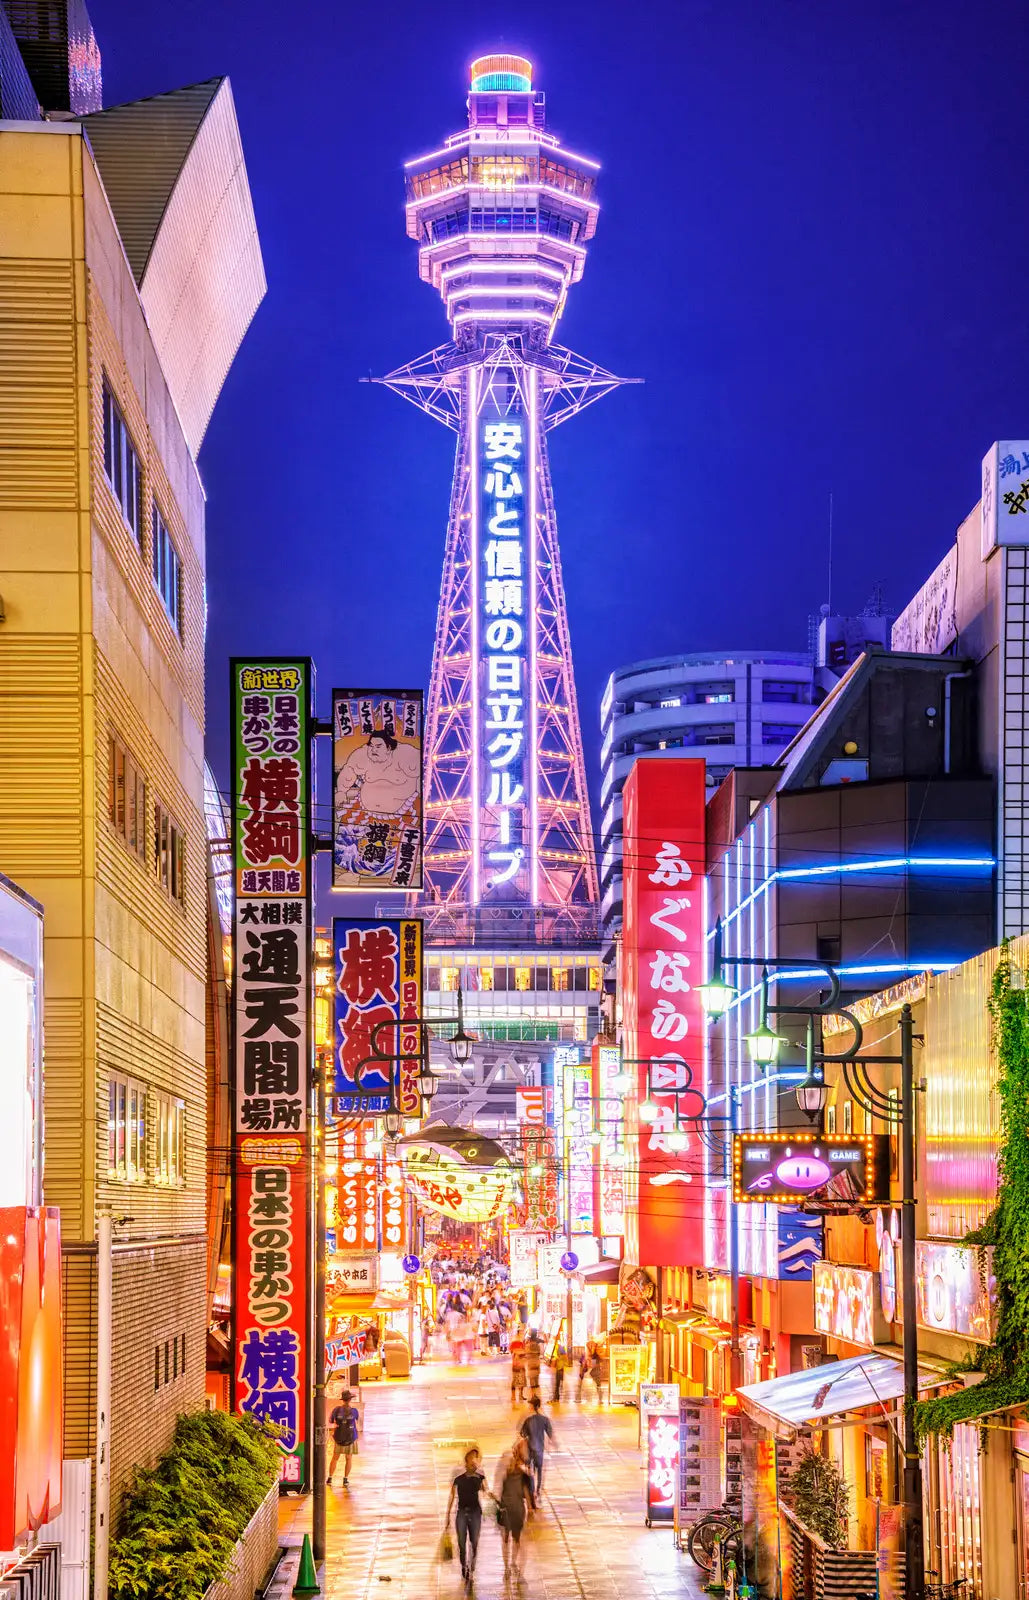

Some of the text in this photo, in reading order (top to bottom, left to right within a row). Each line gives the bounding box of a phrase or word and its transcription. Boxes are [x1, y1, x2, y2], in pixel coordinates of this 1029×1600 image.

[242, 669, 300, 690] 新世界
[484, 422, 525, 888] 安心と信頼の日立グループ
[243, 695, 271, 753] 串かつ
[272, 695, 299, 753] 日本一の
[338, 703, 353, 736] 串かつ
[242, 758, 300, 865] 横綱
[361, 821, 391, 864] 横綱
[242, 870, 300, 893] 通天閣店
[240, 902, 303, 925] 大相撲
[404, 924, 417, 977] 新世界
[241, 928, 302, 1096] 通天閣
[339, 928, 397, 1081] 横綱
[241, 1098, 302, 1131] 場所
[831, 1151, 860, 1160] GAME
[251, 1168, 291, 1323] 日本一の串かつ
[241, 1329, 299, 1450] 横綱
